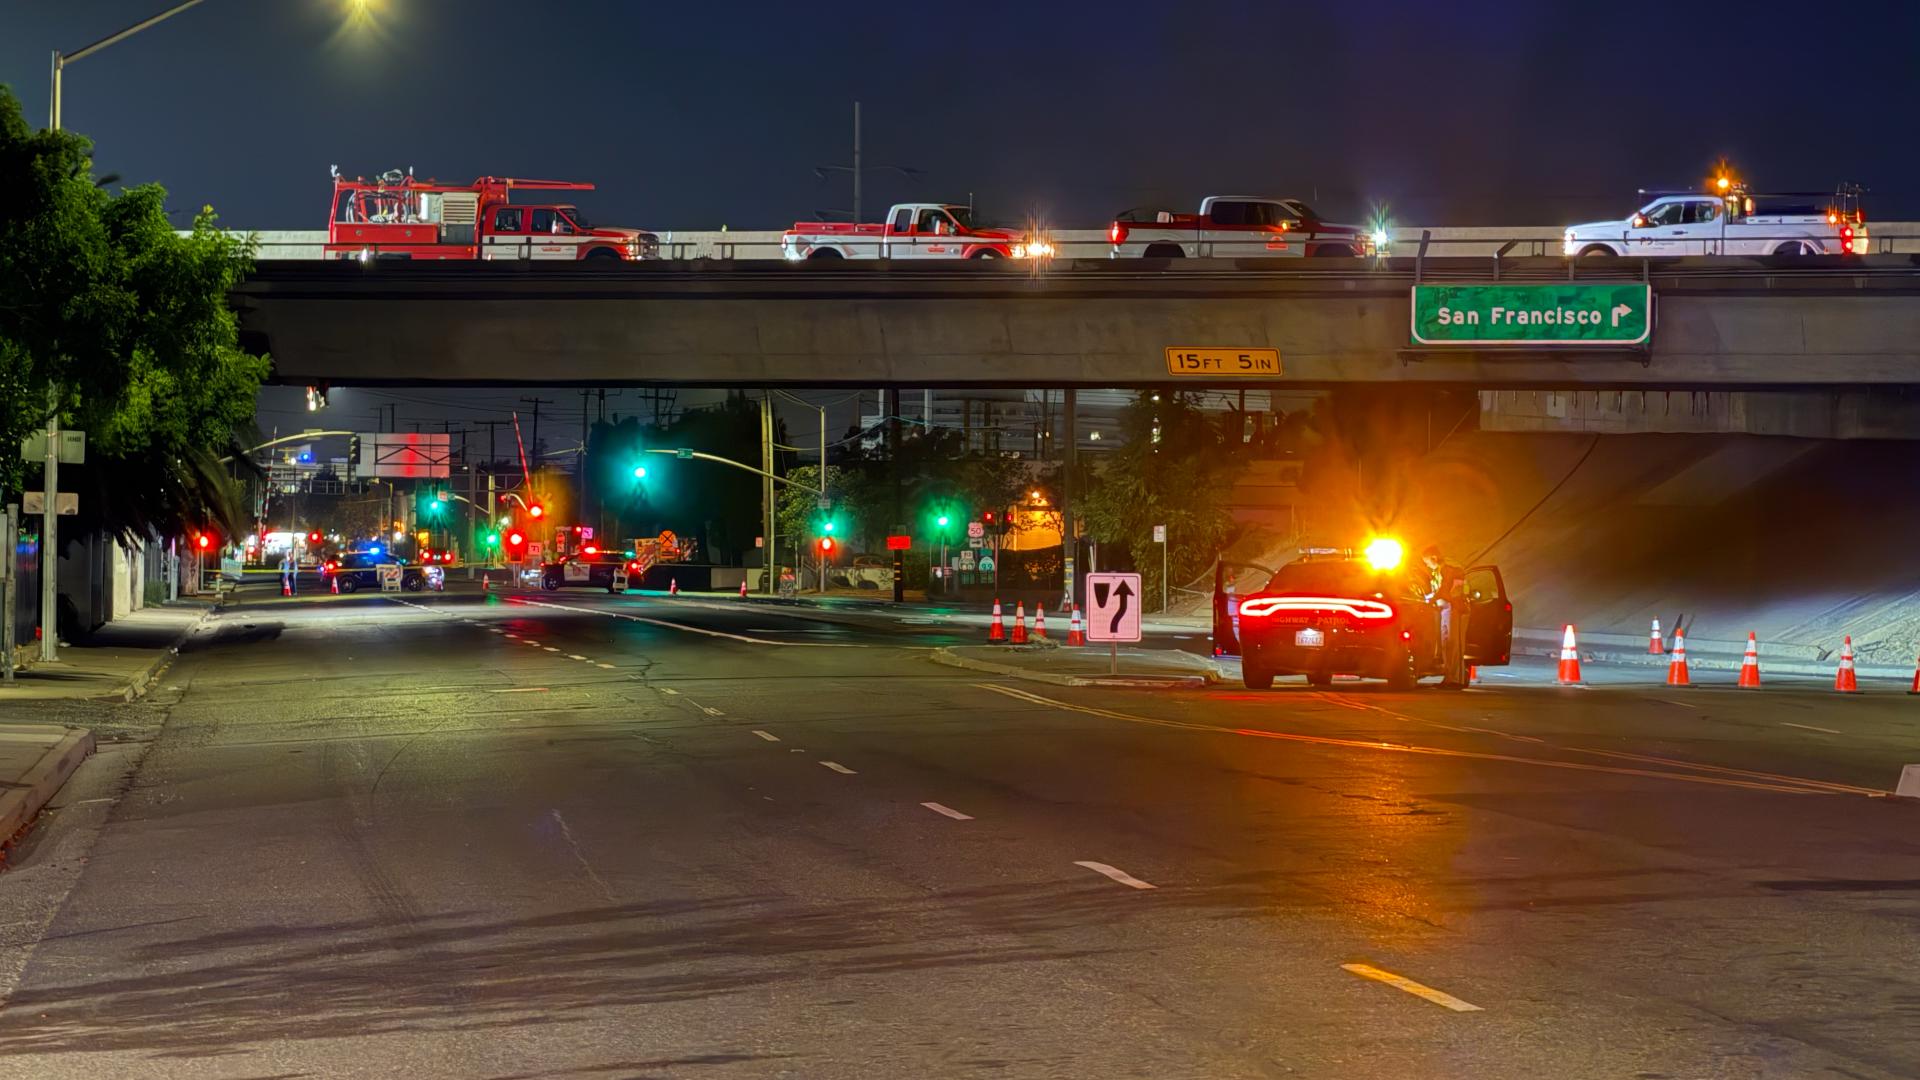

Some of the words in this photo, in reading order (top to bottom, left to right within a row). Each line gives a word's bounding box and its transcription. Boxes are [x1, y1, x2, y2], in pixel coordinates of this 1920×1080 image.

[1438, 307, 1479, 324] San
[1491, 306, 1602, 325] Francisco
[1272, 616, 1310, 624] GHWAY
